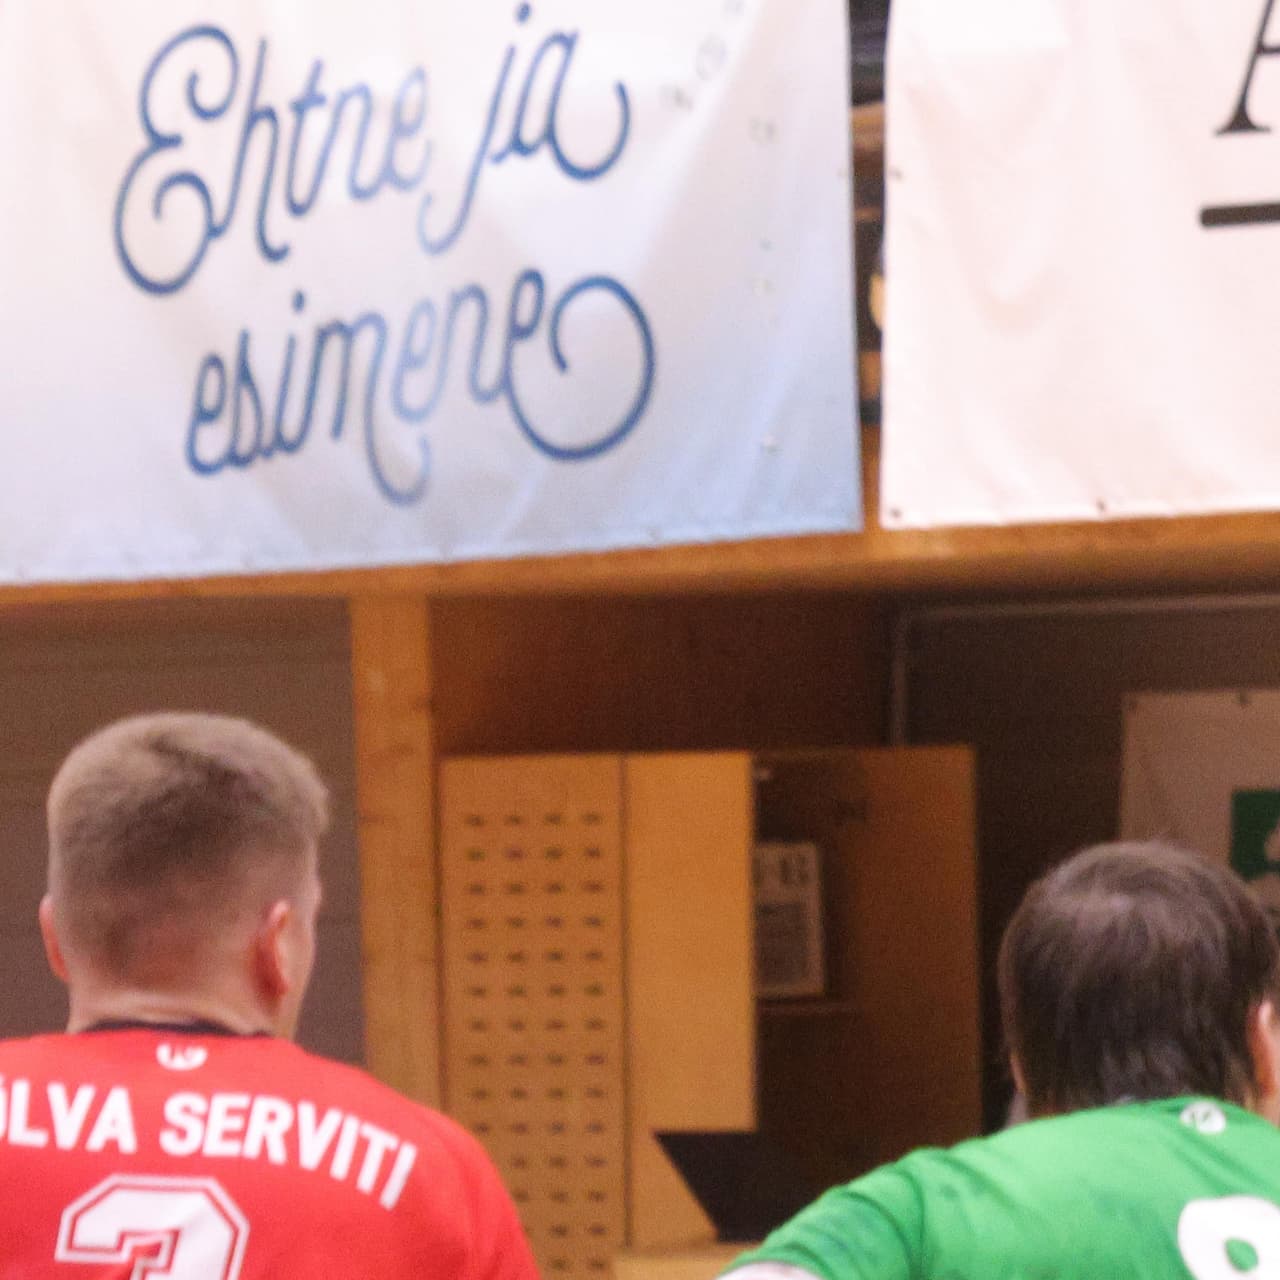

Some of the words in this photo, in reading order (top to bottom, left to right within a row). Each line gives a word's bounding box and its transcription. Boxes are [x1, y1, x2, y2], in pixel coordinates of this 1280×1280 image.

[416, 2, 631, 256] ja
[185, 268, 656, 506] esimene
[0, 1072, 138, 1155] LVA
[159, 1090, 416, 1211] SERVITI
